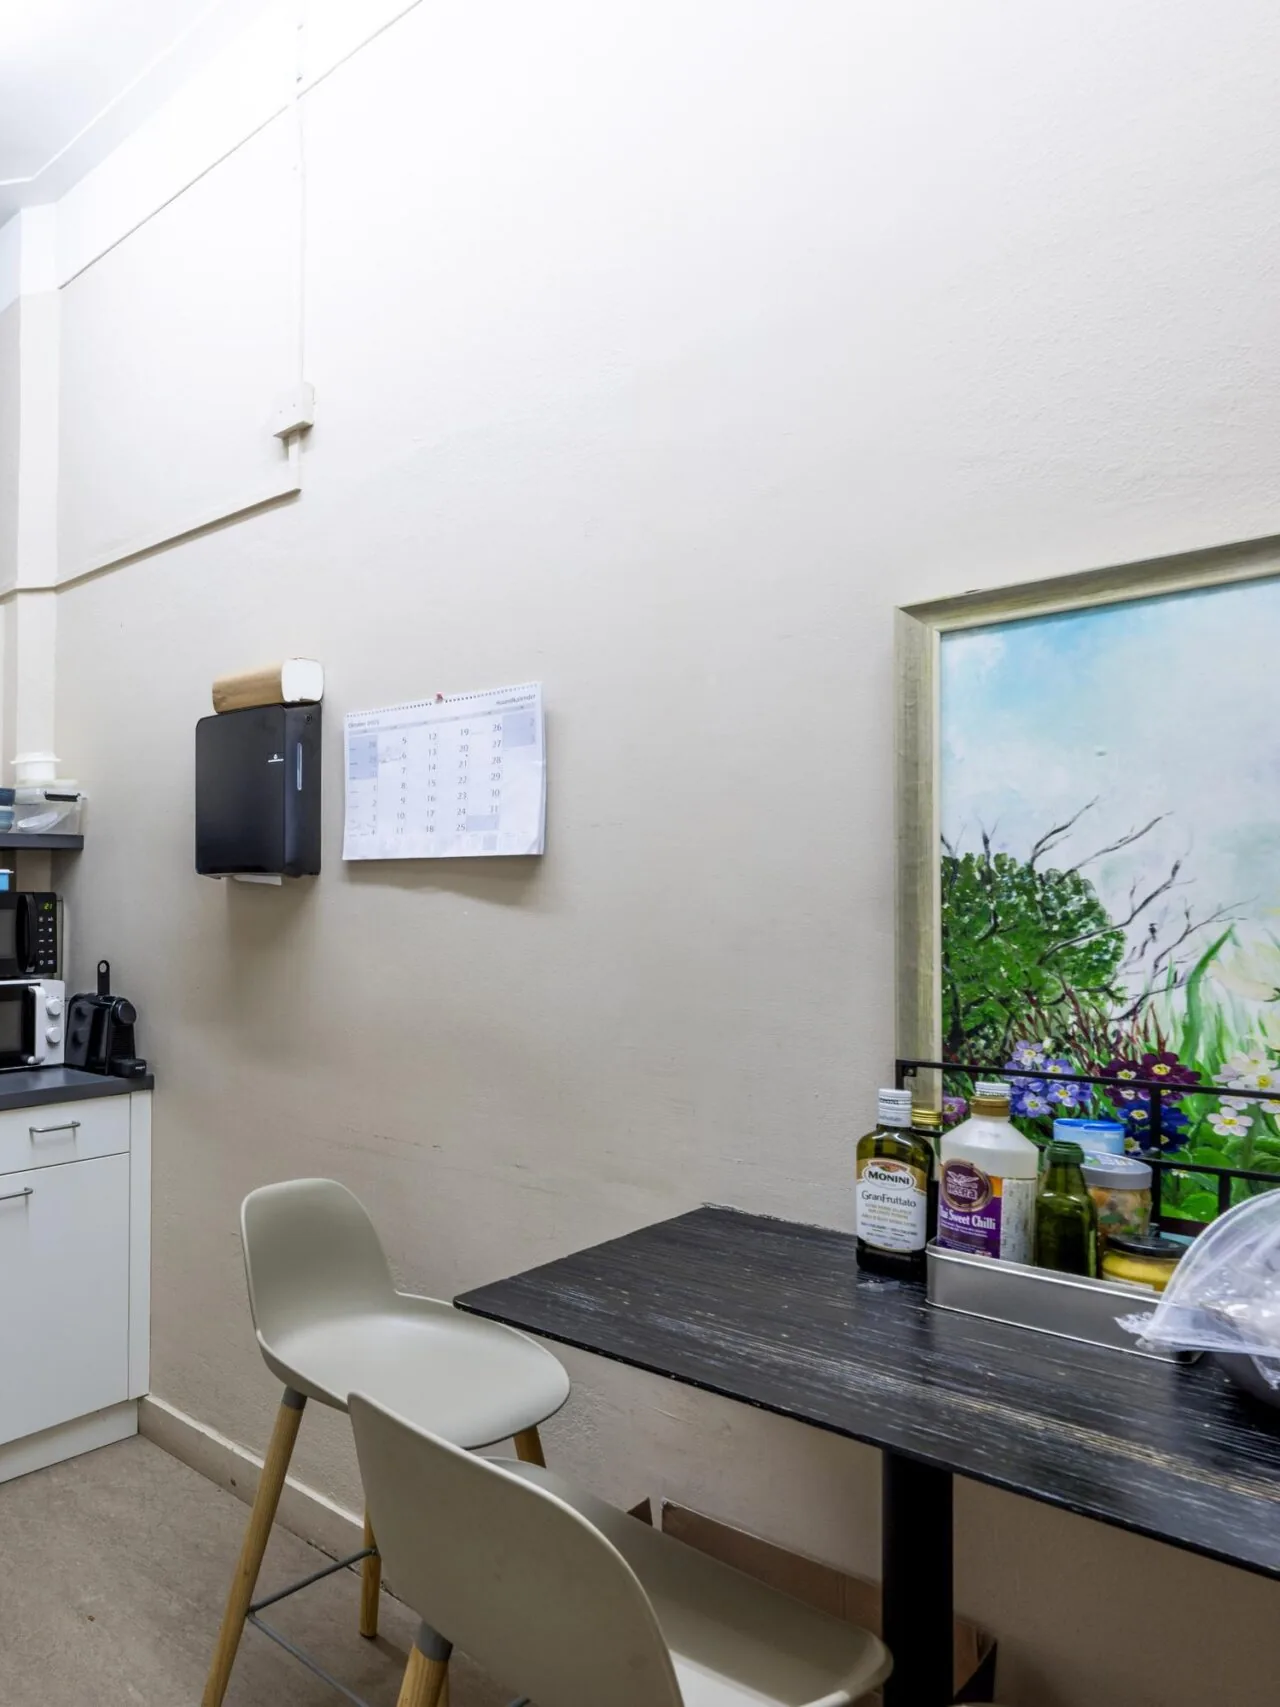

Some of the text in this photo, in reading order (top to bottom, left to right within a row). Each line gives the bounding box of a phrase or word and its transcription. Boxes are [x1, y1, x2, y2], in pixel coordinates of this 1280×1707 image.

[460, 729, 469, 737] 19
[492, 724, 502, 732] 26
[401, 752, 407, 760] 6
[492, 740, 502, 748] 27
[428, 764, 437, 772] 14
[458, 760, 467, 768] 21
[491, 756, 501, 764] 28
[401, 782, 406, 790] 8
[428, 779, 436, 787] 15
[457, 776, 467, 784] 22
[491, 772, 501, 781] 29
[427, 794, 436, 802] 16
[396, 812, 405, 820] 10
[426, 809, 434, 817] 17
[425, 825, 434, 833] 18
[456, 824, 466, 832] 25
[867, 1170, 911, 1185] MONINI
[861, 1190, 918, 1208] GranFruttato
[948, 1209, 970, 1225] Sweet
[971, 1215, 996, 1230] Chilli
